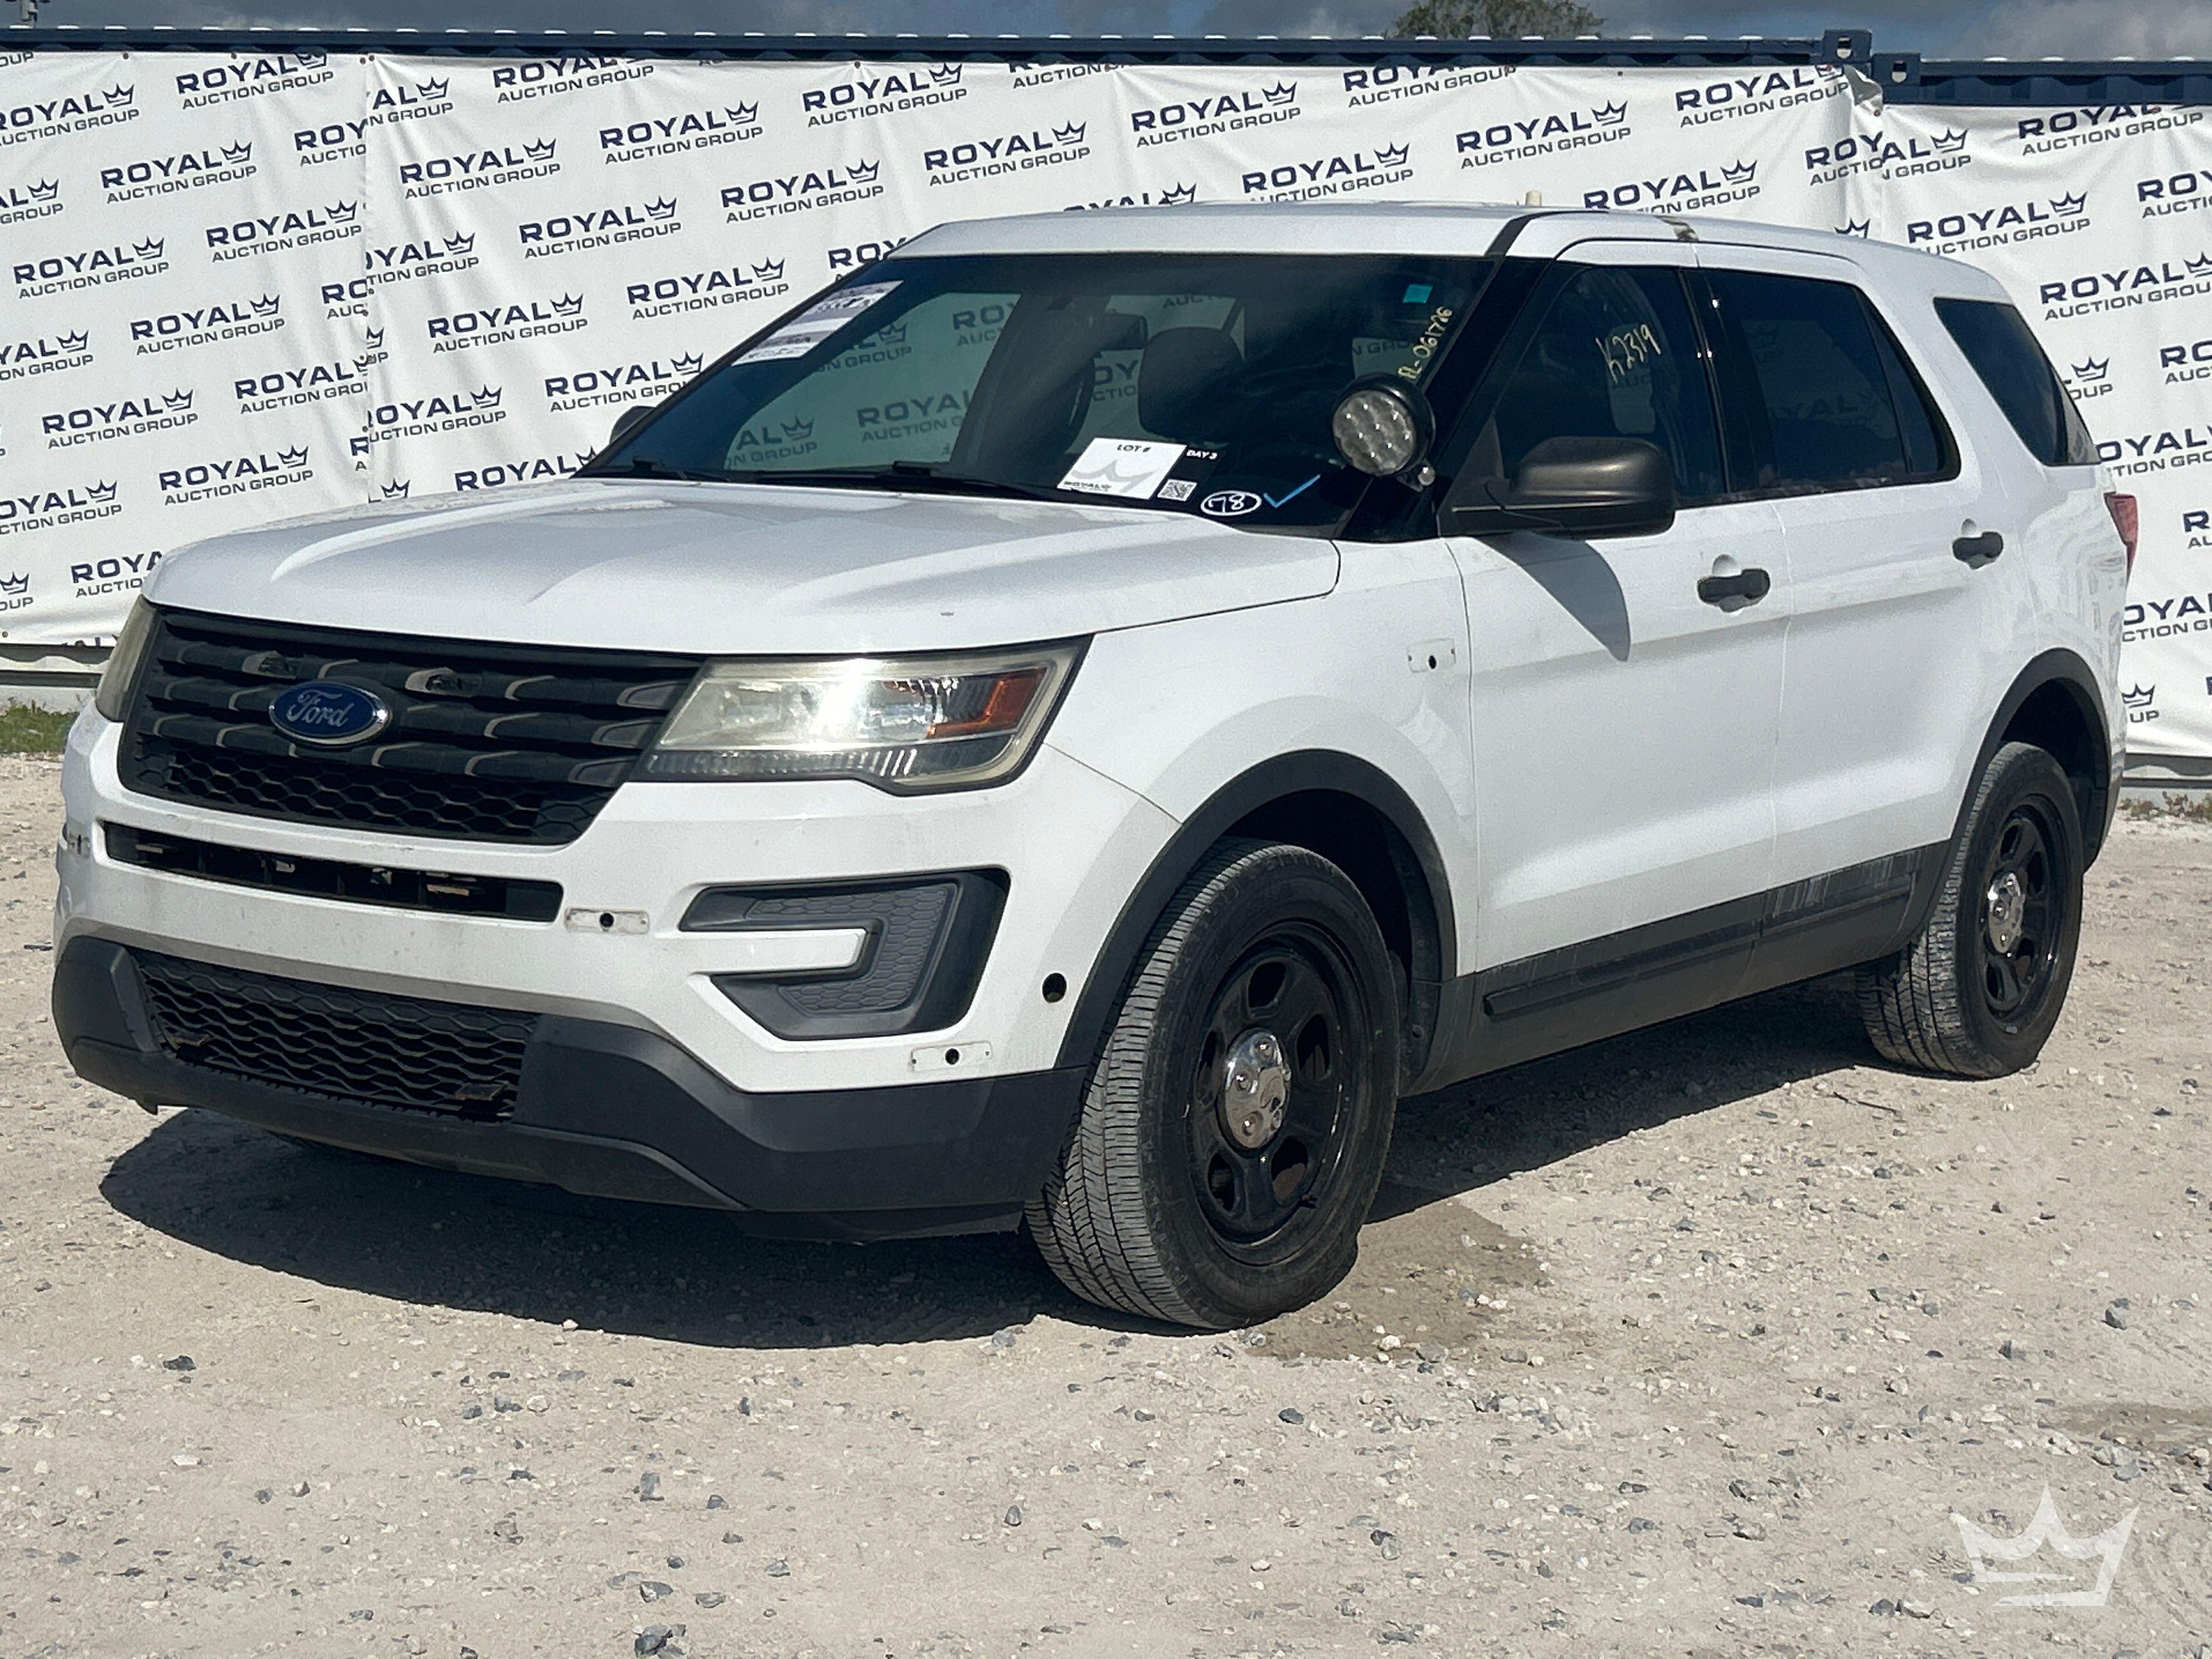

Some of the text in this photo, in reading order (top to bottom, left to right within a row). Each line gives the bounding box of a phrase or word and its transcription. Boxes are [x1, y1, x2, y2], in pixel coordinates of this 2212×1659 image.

[0, 52, 34, 67] OUP
[176, 57, 298, 94] ROYAL
[1013, 64, 1102, 89] AUCTION
[183, 71, 333, 110] AUCTION GROUP
[498, 66, 653, 103] AUCTION GROUP
[802, 72, 930, 112] ROYAL
[1348, 66, 1516, 108] AUCTION GROUP
[1675, 69, 1814, 111] ROYAL
[388, 103, 454, 122] GROUP
[808, 89, 967, 127] AUCTION GROUP
[1131, 92, 1263, 132] ROYAL
[1680, 82, 1849, 128] AUCTION GROUP
[0, 109, 139, 146] UCTION GROUP
[294, 118, 369, 151] ROY
[600, 111, 726, 149] ROYAL
[1137, 108, 1300, 148] AUCTION GROUP
[1456, 112, 1592, 153] ROYAL
[2023, 112, 2203, 156] AUCTION GROUP
[300, 144, 366, 166] AUCTIO
[606, 127, 763, 165] AUCTION GROUP
[924, 132, 1053, 171] ROYAL
[1462, 127, 1630, 169] AUCTION GROUP
[100, 150, 222, 189] ROYAL
[400, 148, 524, 184] ROYAL
[405, 163, 560, 199] AUCTION GROUP
[930, 147, 1090, 187] AUCTION GROUP
[1242, 154, 1375, 193] ROYAL
[1342, 169, 1413, 191] GROUP
[1895, 155, 1971, 179] GROUP
[107, 166, 257, 204] AUCTION GROUP
[721, 169, 847, 207] ROYAL
[1584, 171, 1721, 210] ROYAL
[1686, 186, 1760, 210] GROUP
[1, 204, 63, 224] GROUP
[727, 185, 883, 223] AUCTION GROUP
[2142, 196, 2212, 218] AUCTI
[206, 210, 326, 247] ROYAL
[519, 206, 645, 243] ROYAL
[525, 222, 681, 259] AUCTION GROUP
[1907, 202, 2049, 244] ROYAL
[1925, 218, 2090, 256] UCTION GROUP
[212, 225, 362, 262] AUCTION GROUP
[366, 241, 444, 270] YAL
[14, 247, 134, 284] ROYAL
[19, 262, 169, 298] AUCTION GROUP
[366, 257, 478, 286] TION GROUP
[2040, 263, 2185, 304] ROYAL
[627, 268, 753, 304] ROYAL
[633, 284, 788, 320] AUCTION GROUP
[2045, 281, 2211, 320] AUCTION GROU
[131, 303, 251, 340] ROYAL
[137, 318, 284, 355] AUCTION GROUP
[428, 303, 551, 338] ROYAL
[433, 319, 588, 353] AUCTION GROUP
[29, 354, 93, 375] GROUP
[845, 346, 912, 368] GROUP
[235, 363, 354, 399] ROYAL
[241, 381, 368, 414] AUCTION GRO
[545, 362, 672, 397] ROYAL
[550, 381, 688, 412] AUCTION GRO
[1093, 385, 1137, 402] CTIO
[2069, 383, 2113, 400] OUP
[42, 398, 163, 434] ROYAL
[368, 394, 472, 428] OYAL
[369, 411, 506, 443] UCTION GROUP
[48, 413, 198, 449] AUCTION GROUP
[862, 419, 947, 443] AUCTION
[2095, 428, 2208, 462] OYAL
[751, 442, 817, 462] GROUP
[1187, 449, 1210, 459] DAY
[2113, 450, 2212, 477] TION GRO
[159, 455, 279, 490] ROYAL
[165, 470, 313, 506] AUCTION GROUP
[455, 456, 577, 490] ROYAL
[0, 489, 87, 520] OYAL
[0, 505, 121, 534] CTION GROUP
[1208, 494, 1245, 512] 78
[71, 551, 162, 583] ROYA
[0, 597, 33, 612] OUP
[76, 578, 144, 599] AUCTIO
[2124, 594, 2212, 625] OYA
[2122, 622, 2188, 642] CTION
[285, 689, 354, 727] Ford
